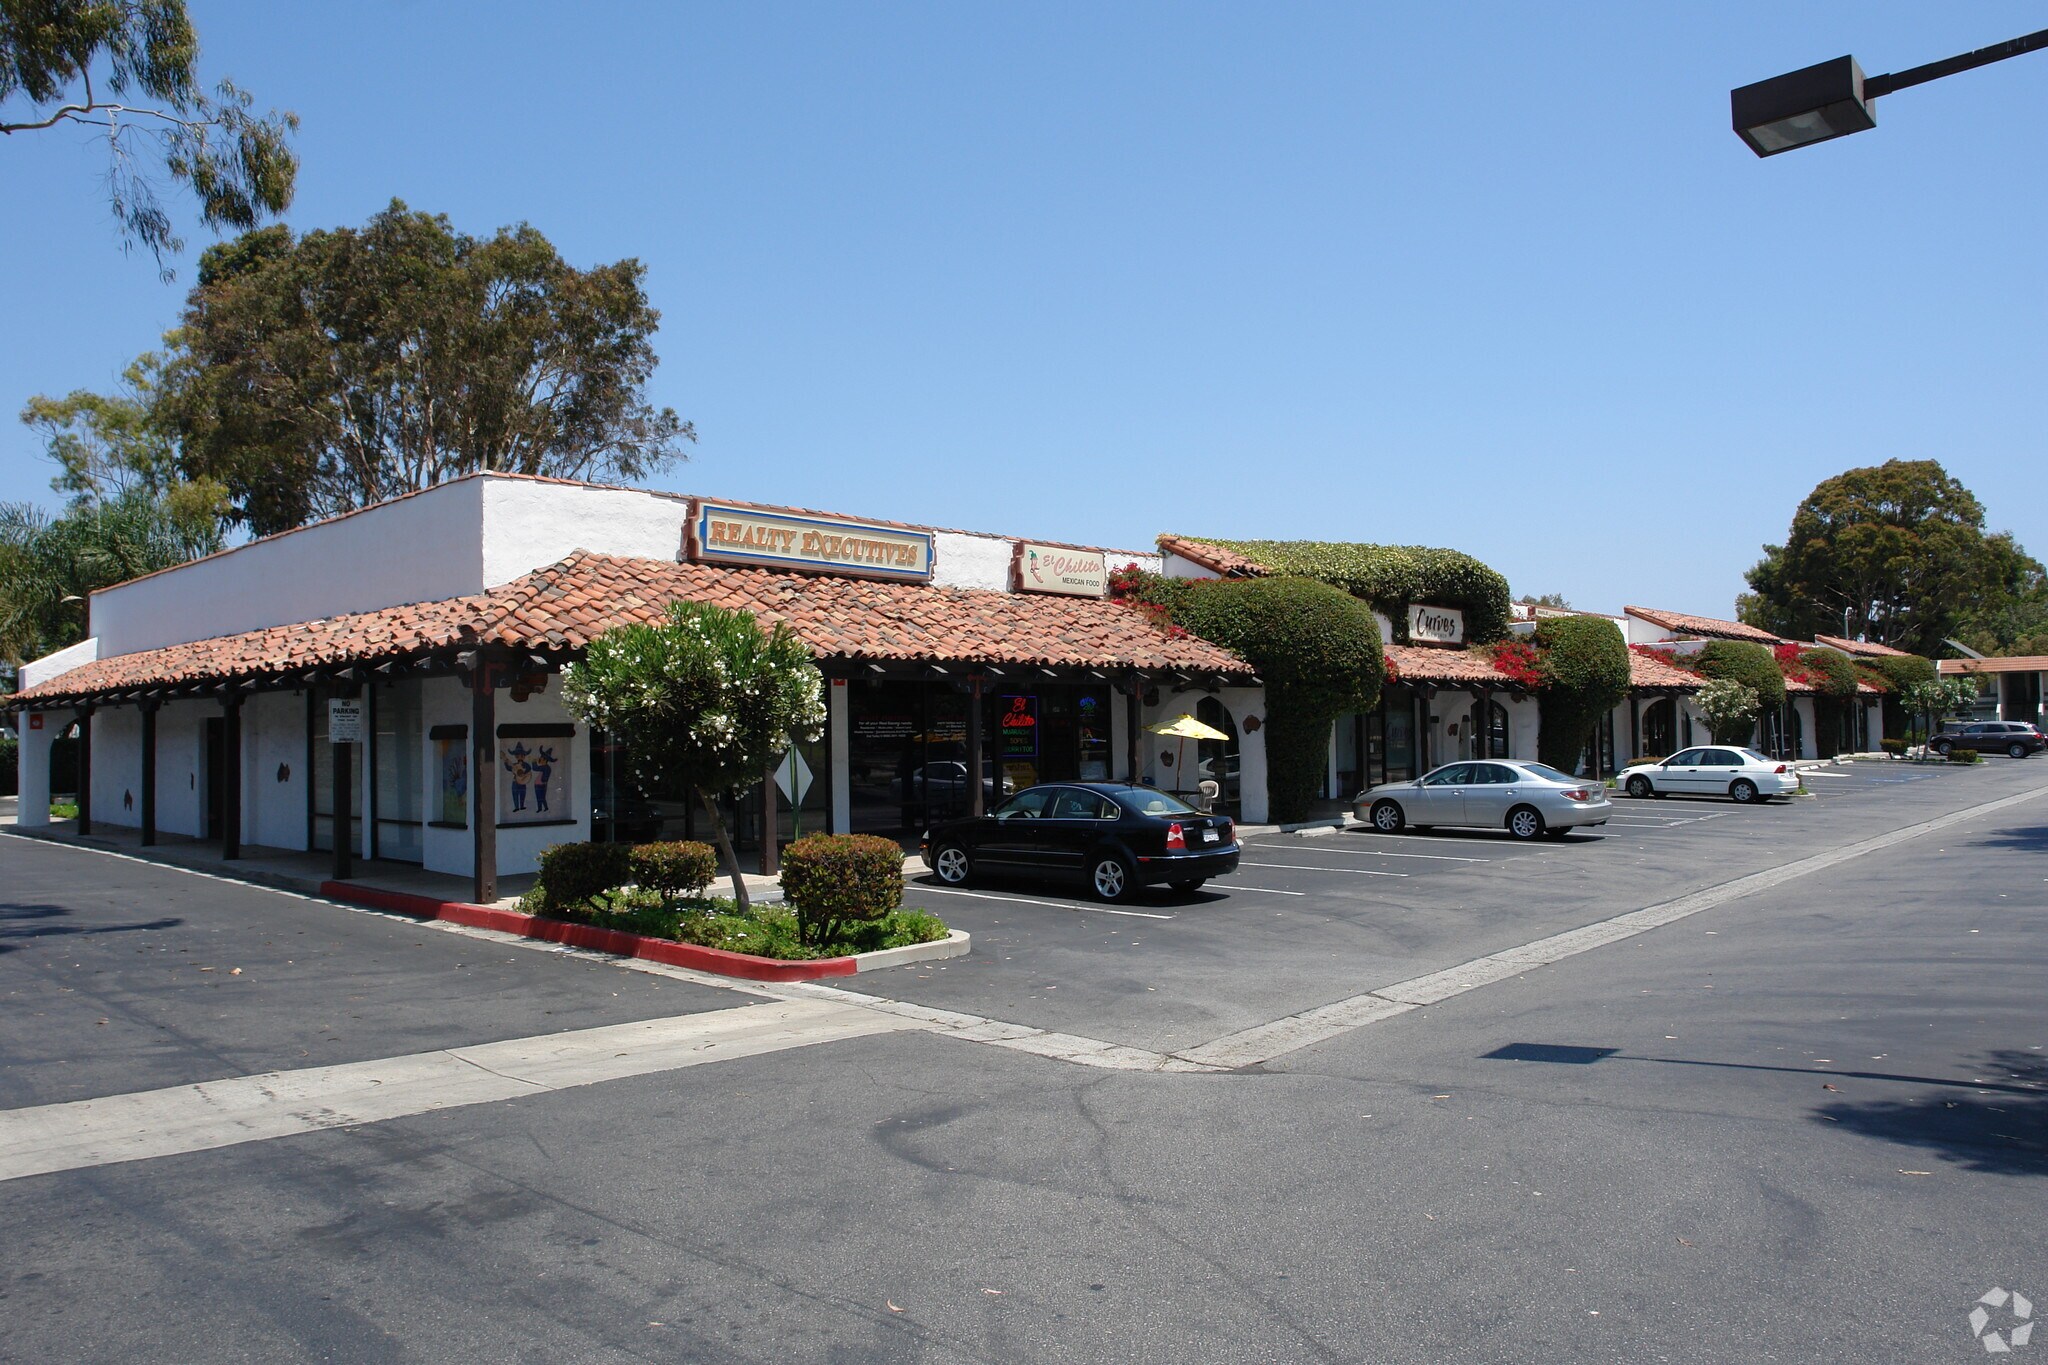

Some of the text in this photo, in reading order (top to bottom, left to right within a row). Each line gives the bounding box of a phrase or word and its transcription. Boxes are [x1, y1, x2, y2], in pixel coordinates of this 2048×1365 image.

[709, 520, 919, 567] REALTY EXECUTIVES
[1043, 555, 1101, 577] El Chilito
[1062, 577, 1100, 587] MEXICAN FOOD
[1416, 608, 1455, 637] Curves
[332, 707, 360, 715] PARKING
[1012, 697, 1027, 712] El
